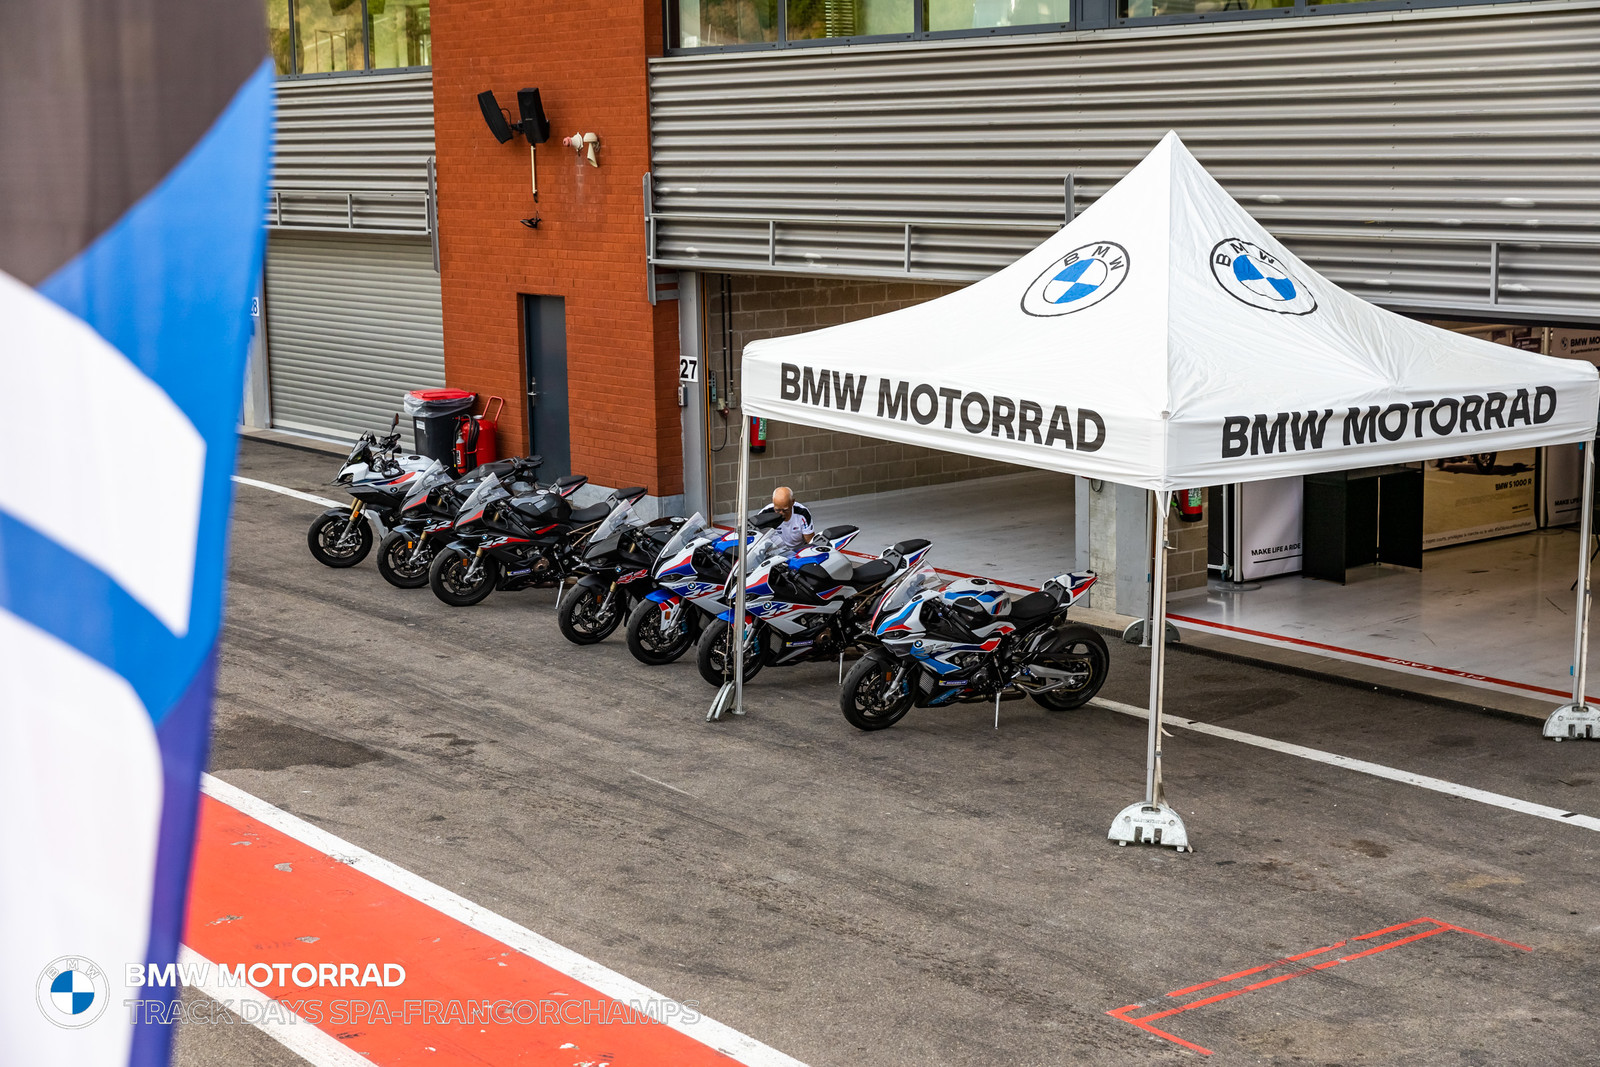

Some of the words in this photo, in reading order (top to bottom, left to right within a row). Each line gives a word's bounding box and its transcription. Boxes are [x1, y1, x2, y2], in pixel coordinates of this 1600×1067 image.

[1063, 245, 1125, 271] BMW
[1215, 243, 1275, 267] BMW
[1570, 337, 1587, 347] BMW
[680, 358, 697, 379] 27
[780, 362, 867, 412] BMW
[877, 377, 1106, 452] MOTORRAD
[1221, 409, 1333, 459] BMW
[1342, 385, 1557, 446] MOTORRAD
[1495, 481, 1508, 491] BMW
[1513, 478, 1527, 488] 1000
[1527, 477, 1532, 486] R
[1251, 547, 1271, 556] MAKE
[1272, 545, 1284, 554] LIFE
[1289, 542, 1302, 551] RIDE
